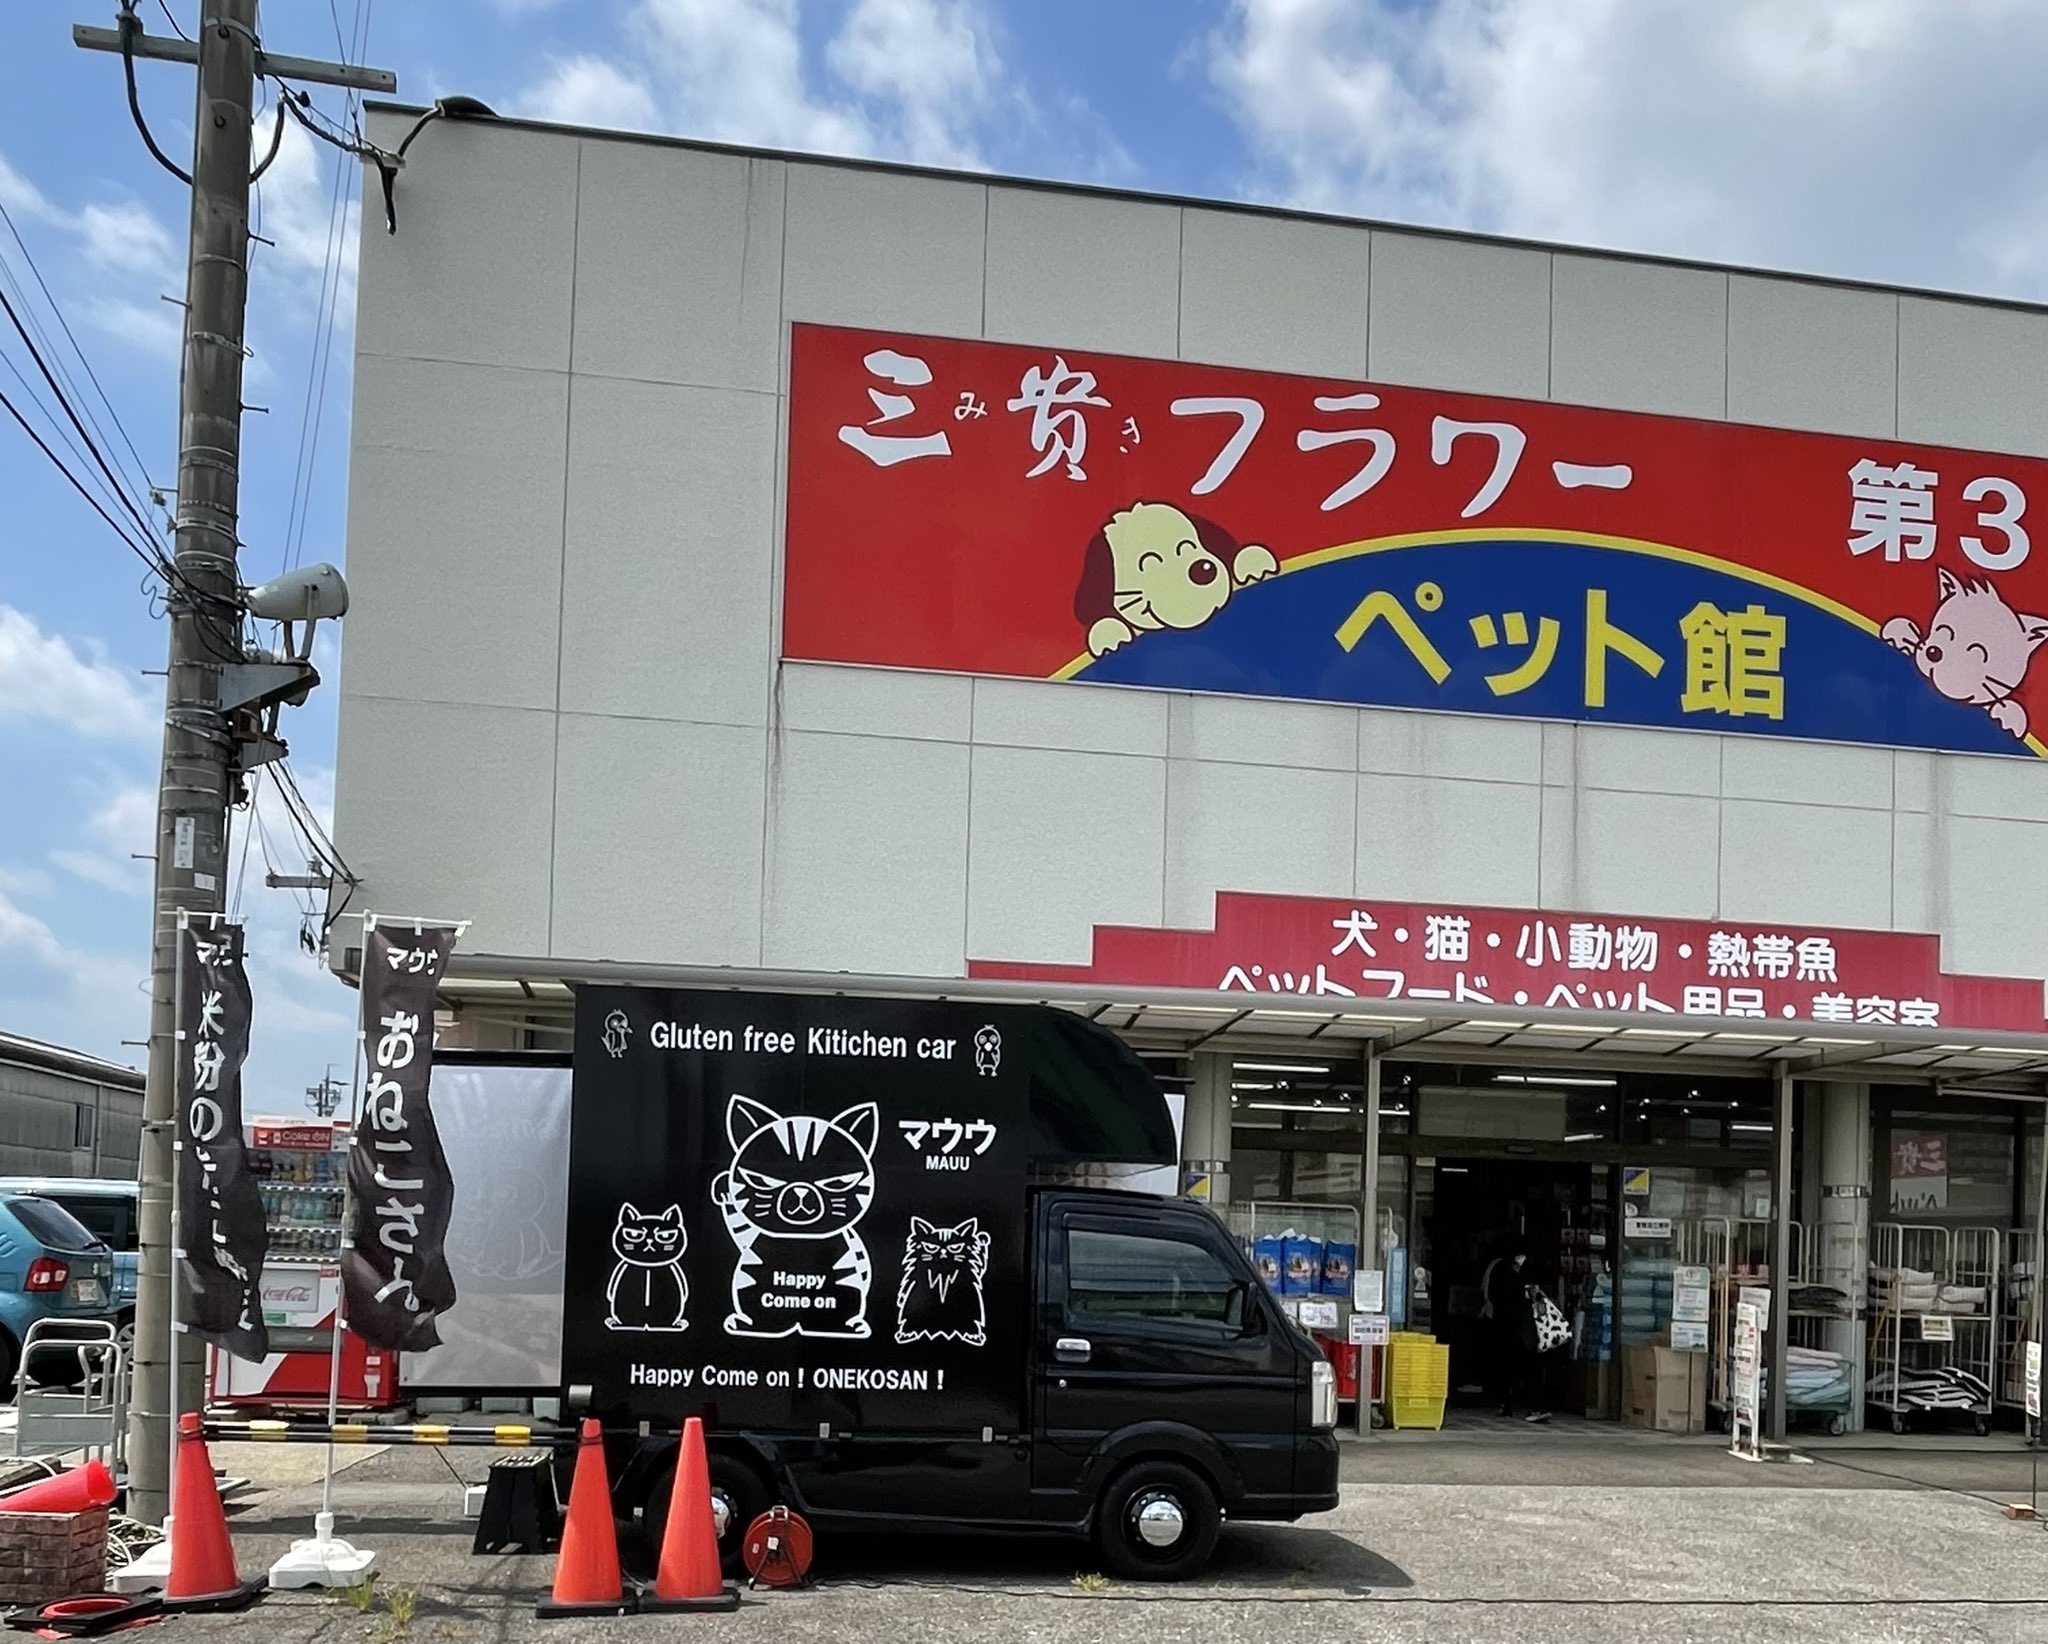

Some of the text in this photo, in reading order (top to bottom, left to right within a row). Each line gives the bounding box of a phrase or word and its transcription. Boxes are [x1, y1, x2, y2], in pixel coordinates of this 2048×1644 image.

[1847, 457, 2032, 572] 第3
[1333, 579, 1788, 722] ペット館
[1330, 909, 1839, 984] 犬・猫・小動物・熱帯魚
[650, 1020, 958, 1061] Gluten free Kitichen car
[282, 1130, 310, 1142] Coke
[898, 1117, 998, 1157] マウウ
[925, 1155, 971, 1172] MAUU
[773, 1270, 827, 1290] Happy
[761, 1292, 837, 1309] Come on
[630, 1363, 694, 1389] Happy
[701, 1364, 759, 1388] Come
